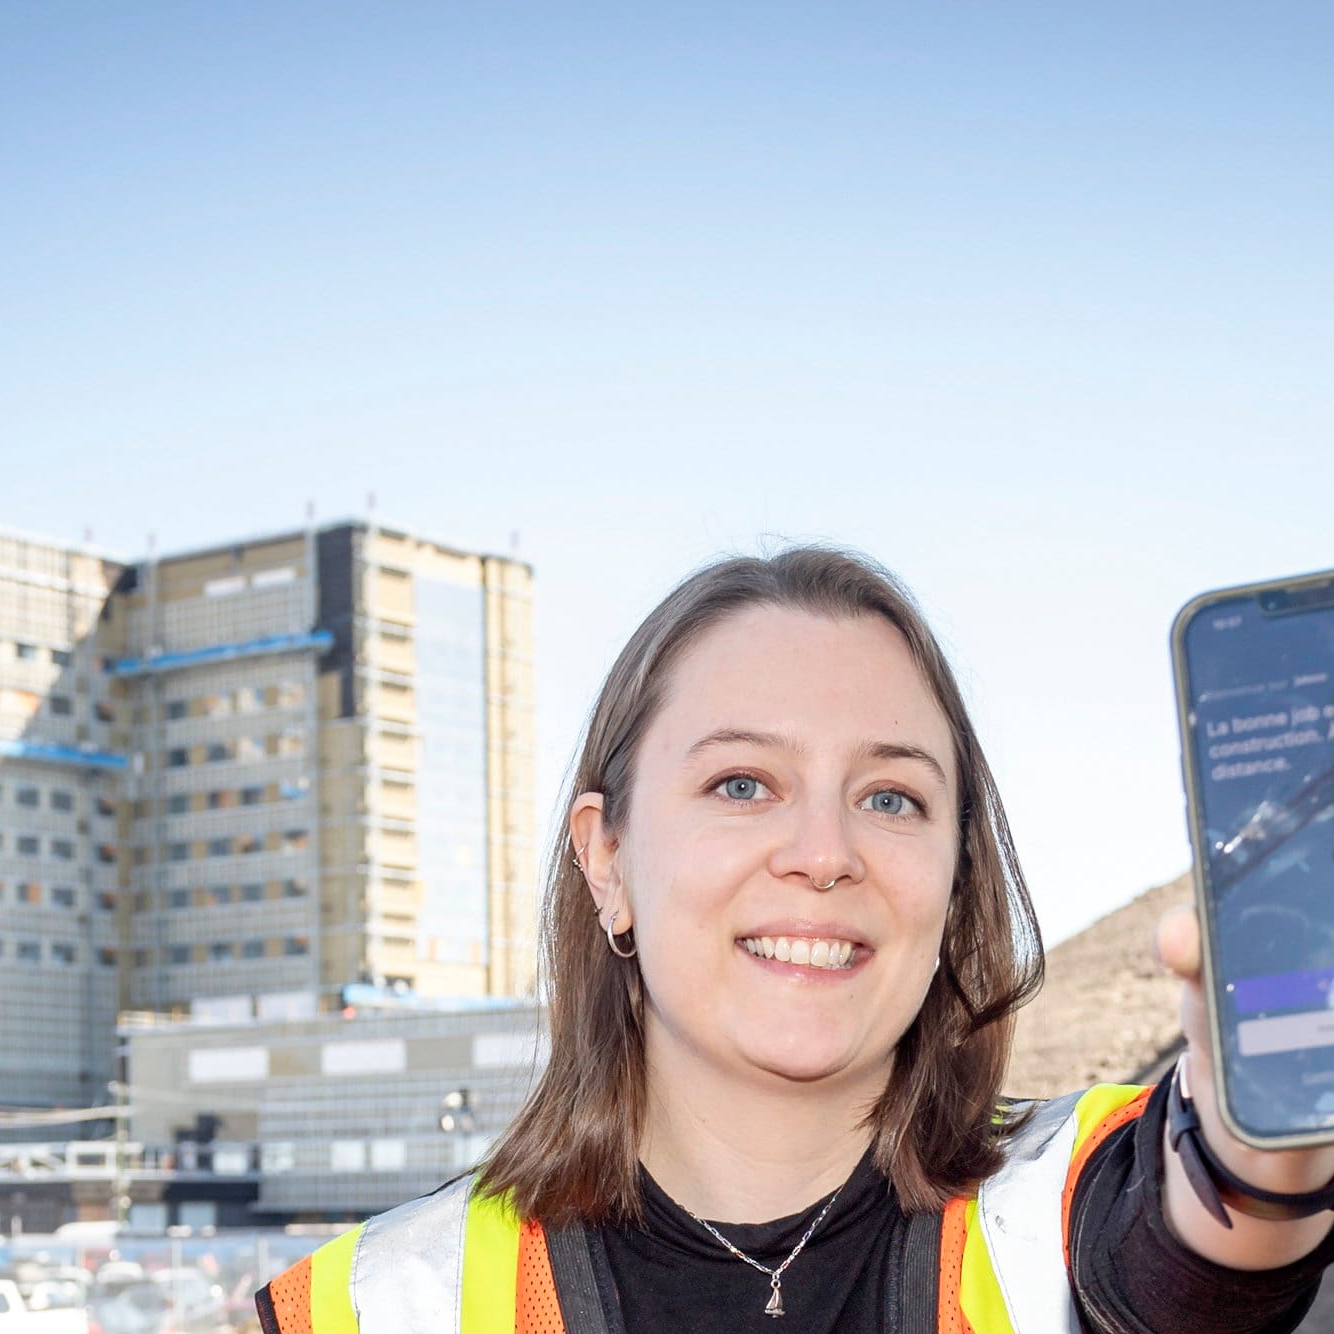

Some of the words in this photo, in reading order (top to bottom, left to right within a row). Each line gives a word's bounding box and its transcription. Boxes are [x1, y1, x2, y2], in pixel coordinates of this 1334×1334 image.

[1206, 721, 1230, 738] La
[1231, 711, 1288, 734] bonne
[1290, 704, 1321, 726] job
